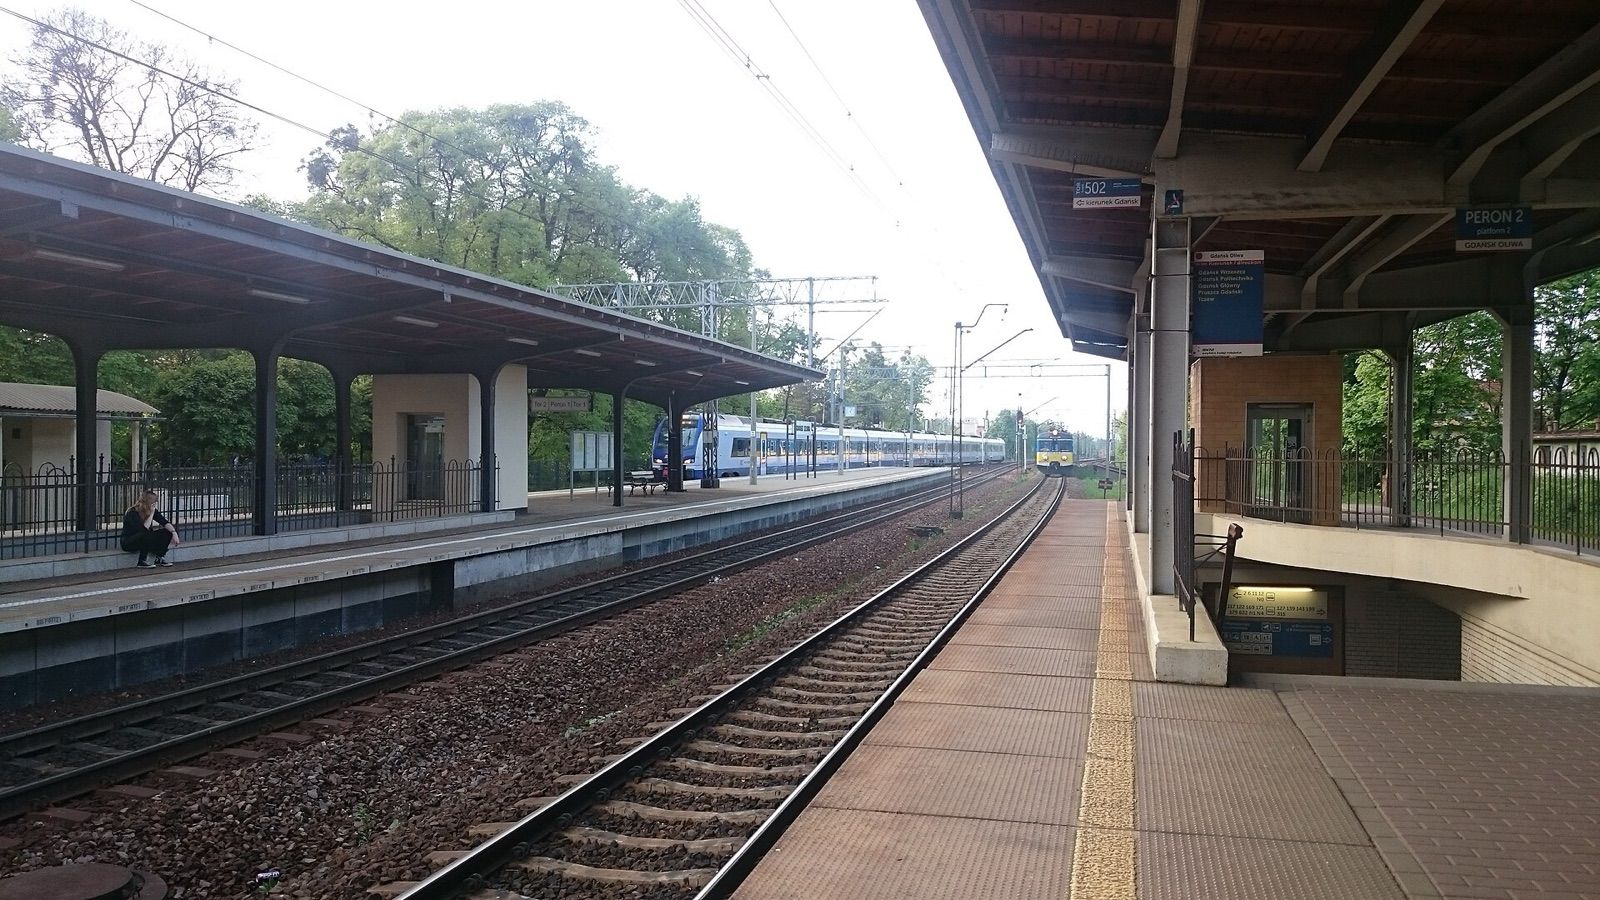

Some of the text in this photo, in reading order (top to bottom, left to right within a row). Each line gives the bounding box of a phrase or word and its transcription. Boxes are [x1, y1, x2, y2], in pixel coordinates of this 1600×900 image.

[1085, 181, 1106, 194] 502
[1465, 209, 1524, 224] PERON 2
[1476, 227, 1505, 235] platform
